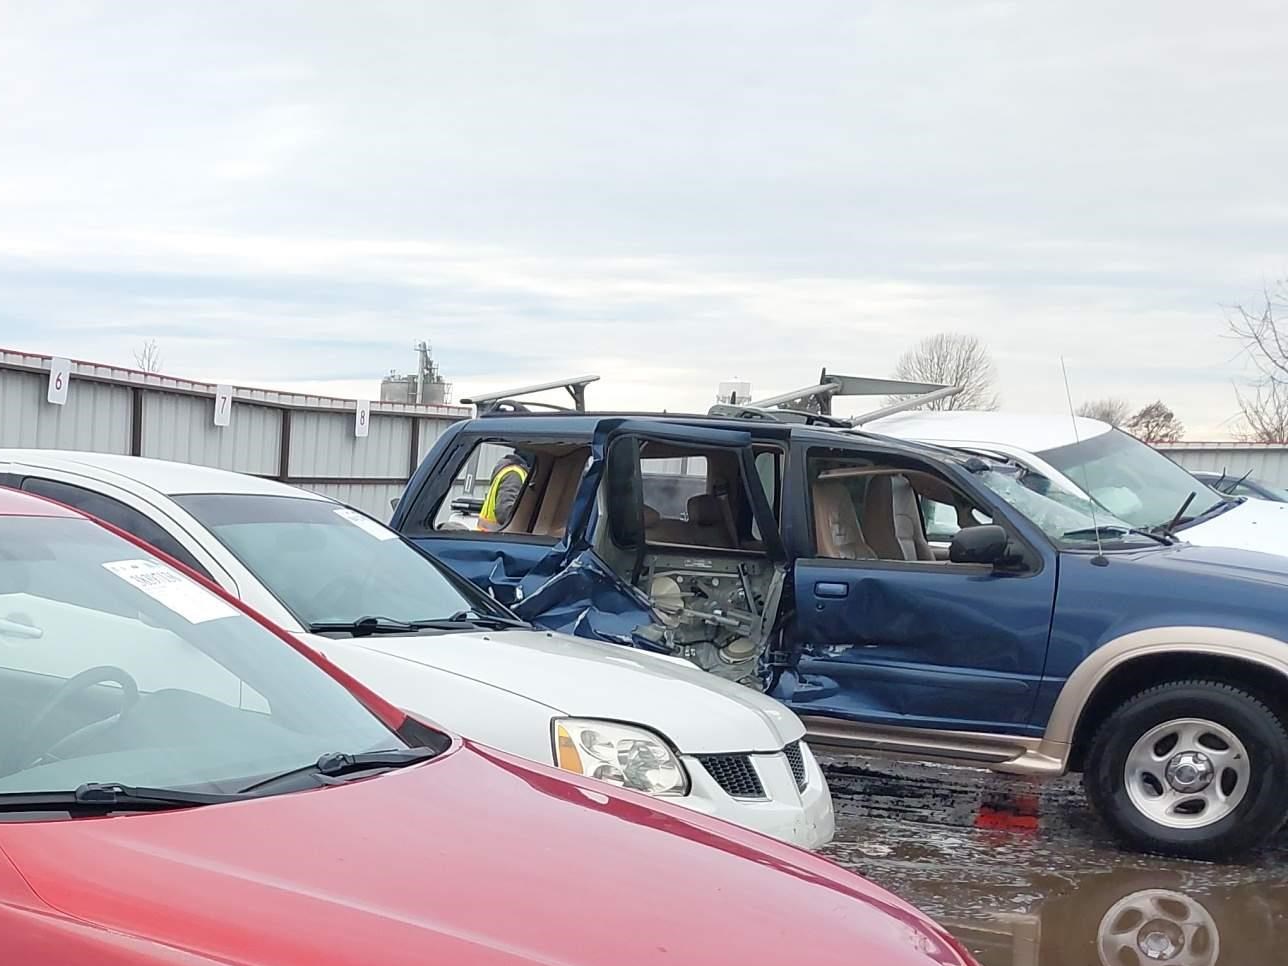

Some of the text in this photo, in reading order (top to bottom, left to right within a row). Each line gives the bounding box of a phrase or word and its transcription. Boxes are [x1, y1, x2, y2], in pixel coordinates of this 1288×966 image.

[55, 372, 62, 390] 6
[221, 396, 227, 414] 7
[359, 410, 366, 425] 8
